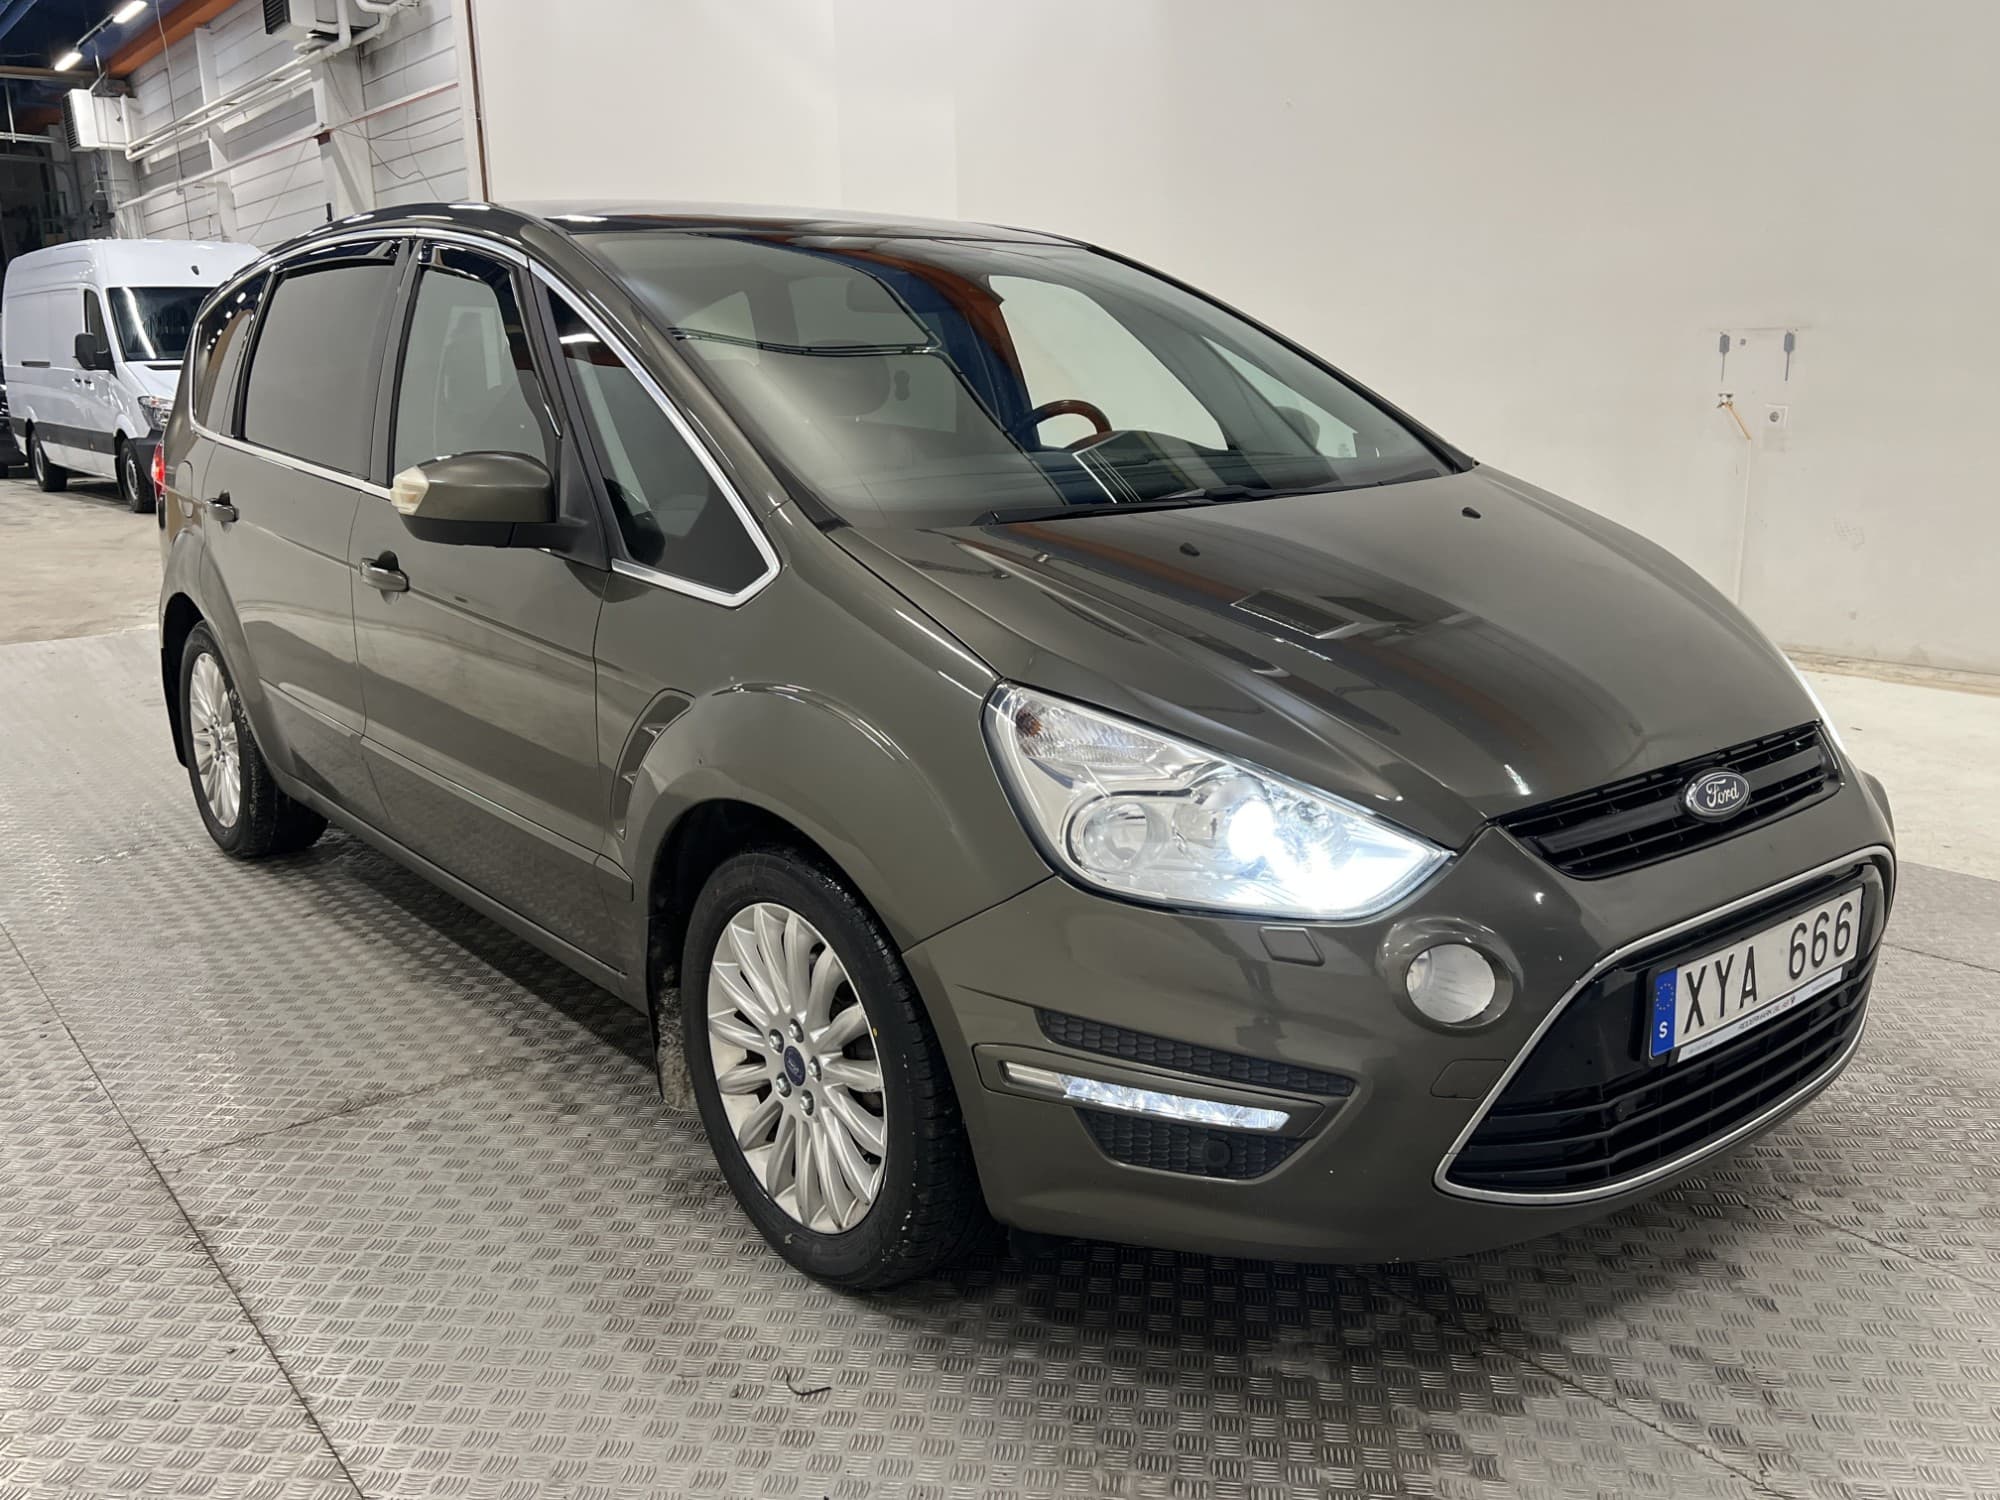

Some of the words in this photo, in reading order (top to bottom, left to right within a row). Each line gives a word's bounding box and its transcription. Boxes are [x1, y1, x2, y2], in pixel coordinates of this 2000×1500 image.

[1705, 778, 1740, 808] Ford
[1683, 945, 1758, 1034] XYA
[1788, 901, 1853, 980] 666
[1658, 1021, 1668, 1039] S
